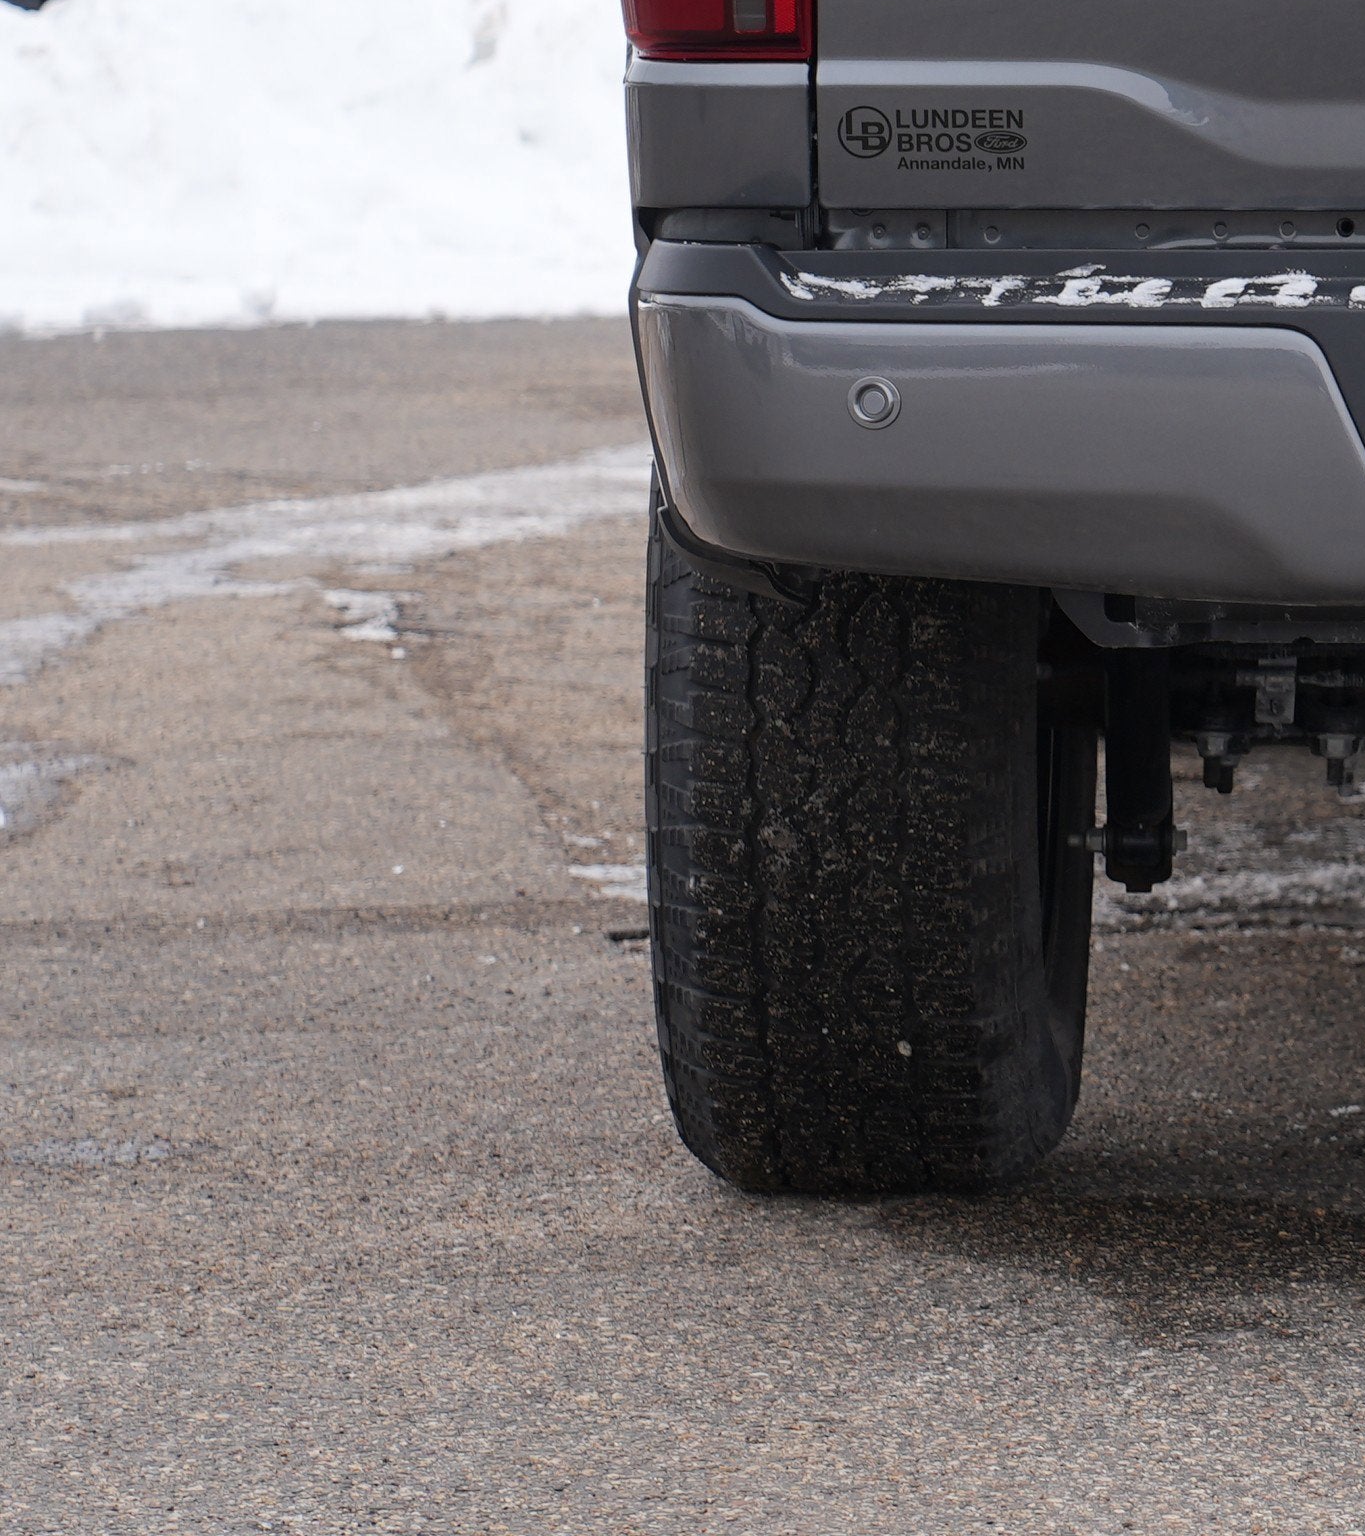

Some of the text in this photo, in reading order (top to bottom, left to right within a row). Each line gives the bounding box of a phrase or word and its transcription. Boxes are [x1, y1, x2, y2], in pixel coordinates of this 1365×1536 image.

[896, 109, 1023, 129] LUNDEEN
[897, 133, 972, 152] BROS
[897, 157, 1025, 172] Annandale, MN
